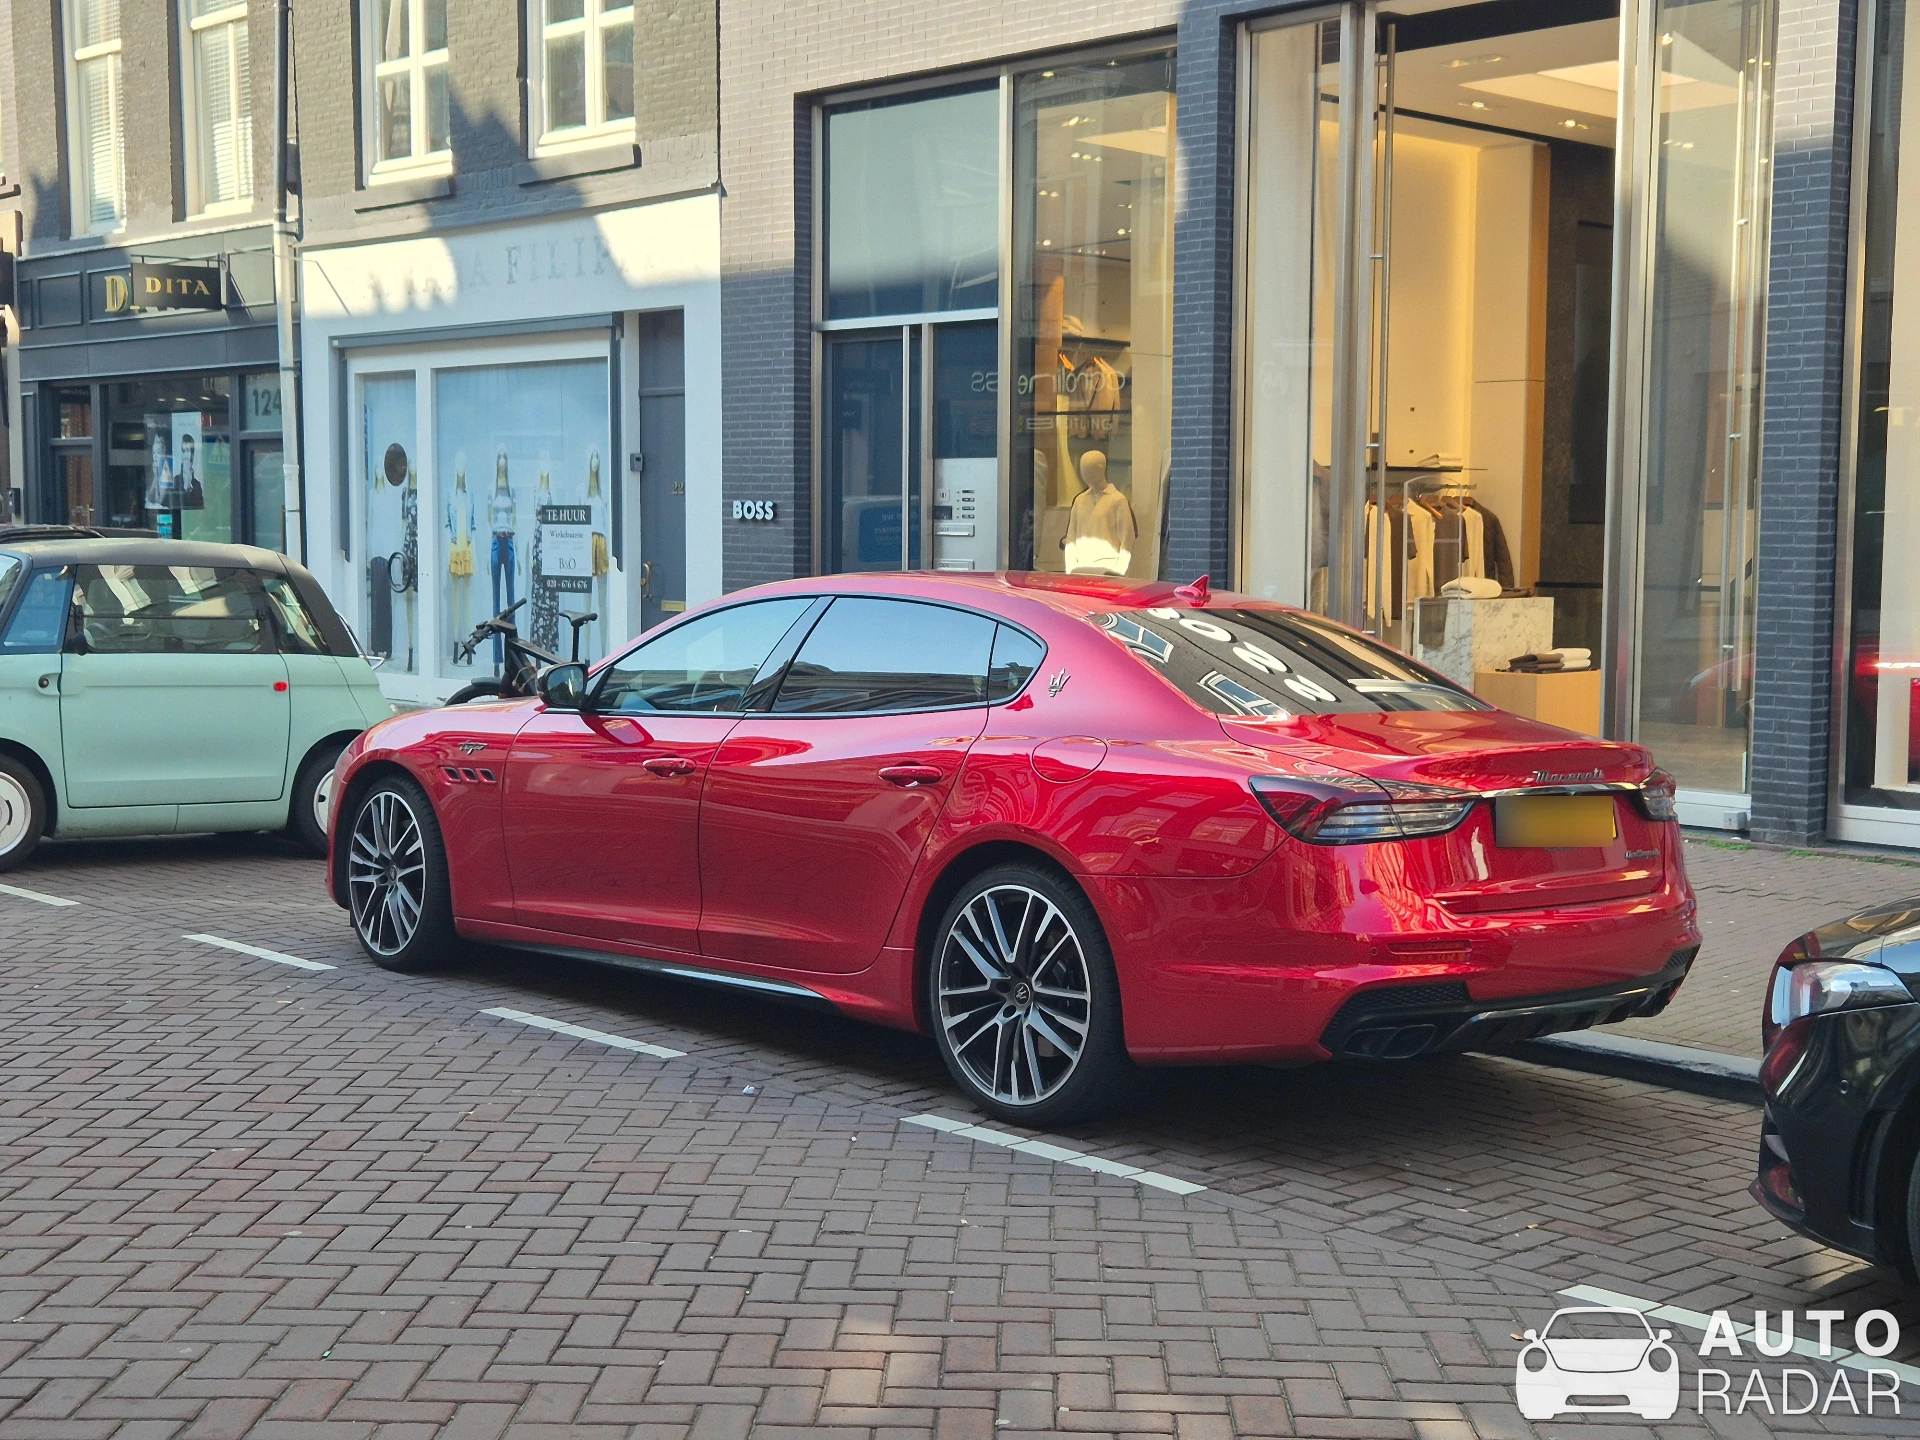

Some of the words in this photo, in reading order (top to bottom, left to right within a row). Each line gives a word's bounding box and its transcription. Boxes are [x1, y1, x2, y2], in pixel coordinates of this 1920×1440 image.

[145, 276, 211, 295] DITA
[252, 388, 282, 417] 124
[1025, 416, 1113, 432] BITLING
[546, 509, 558, 521] TE
[560, 509, 586, 521] HUUR
[732, 500, 774, 520] BOSS
[1532, 767, 1604, 783] Maserati
